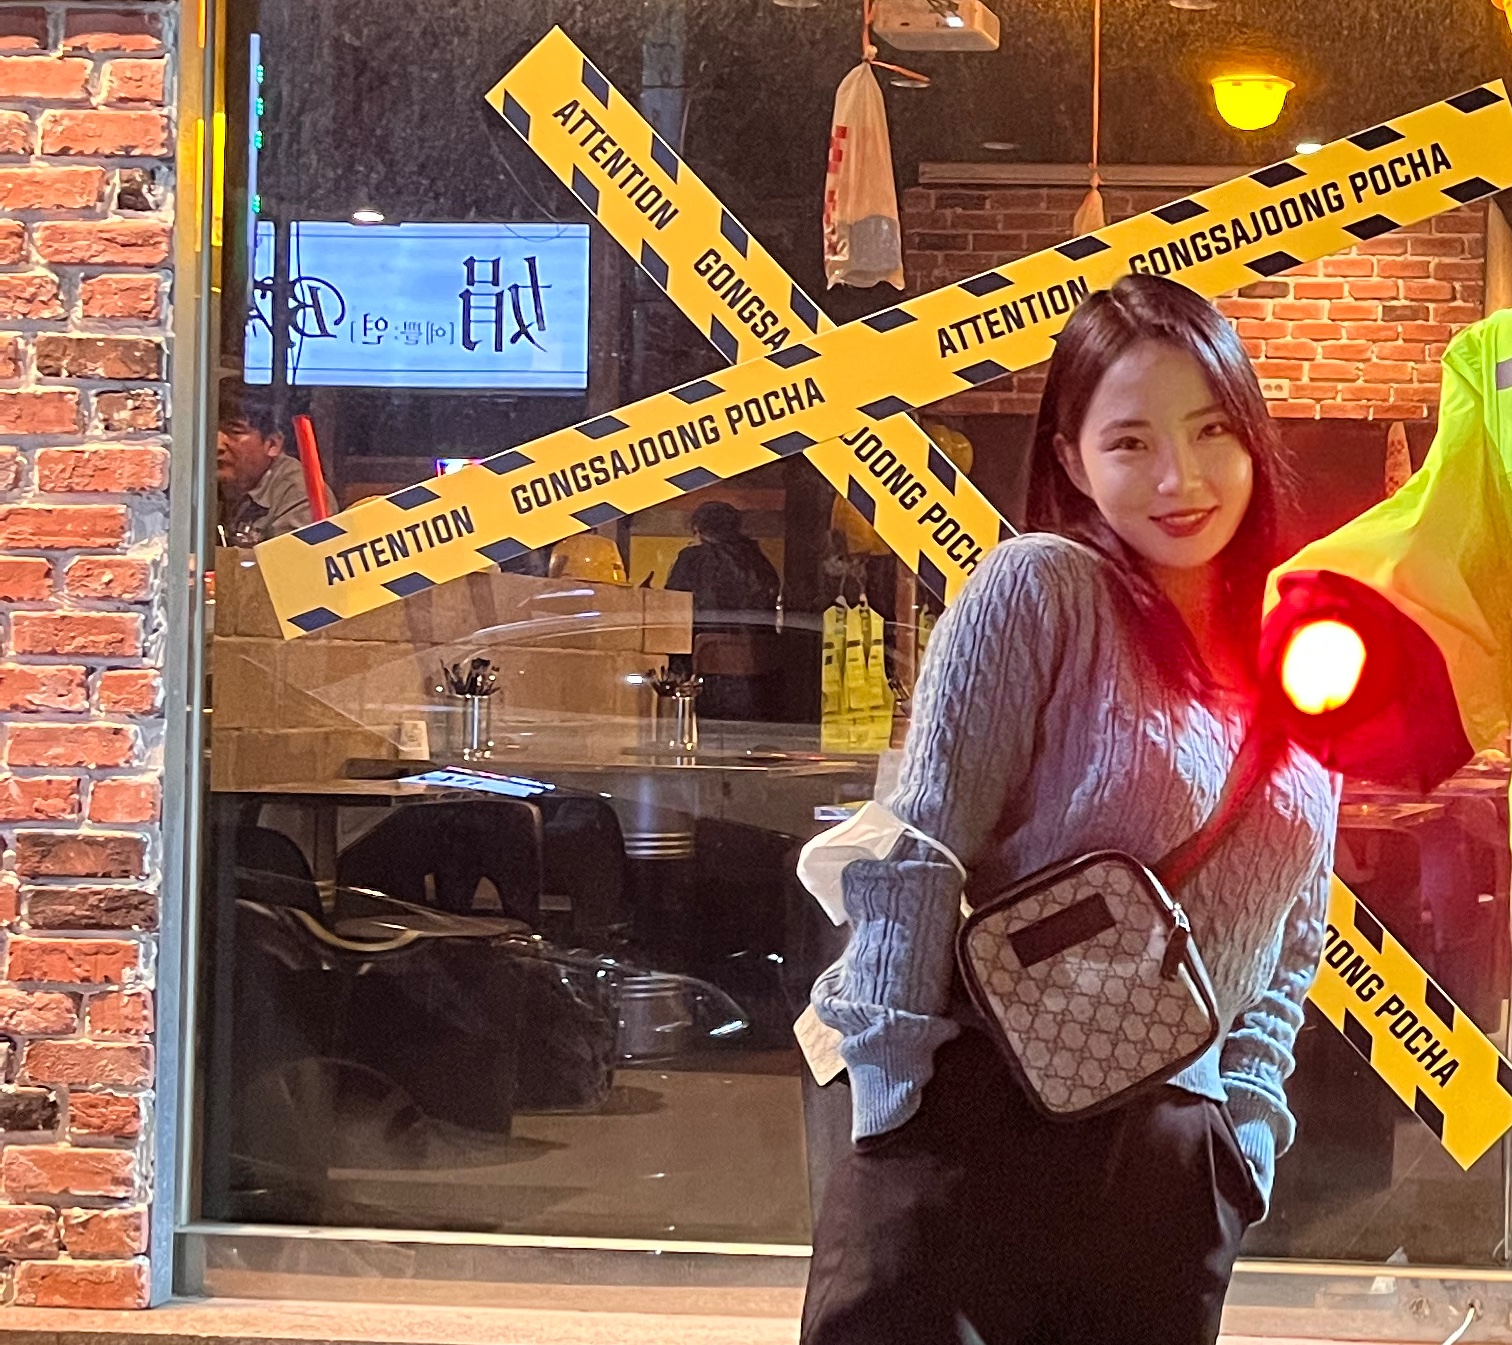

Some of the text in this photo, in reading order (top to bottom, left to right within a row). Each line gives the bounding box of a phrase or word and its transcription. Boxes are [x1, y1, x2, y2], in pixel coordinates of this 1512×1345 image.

[552, 99, 680, 231] ATTENTION
[324, 141, 1453, 586] ATTENTION GONGSAJOONG POCHA ATTENTION GONGSAJOONG POCHA
[916, 501, 983, 577] POCH
[1373, 993, 1460, 1089] POCHA
